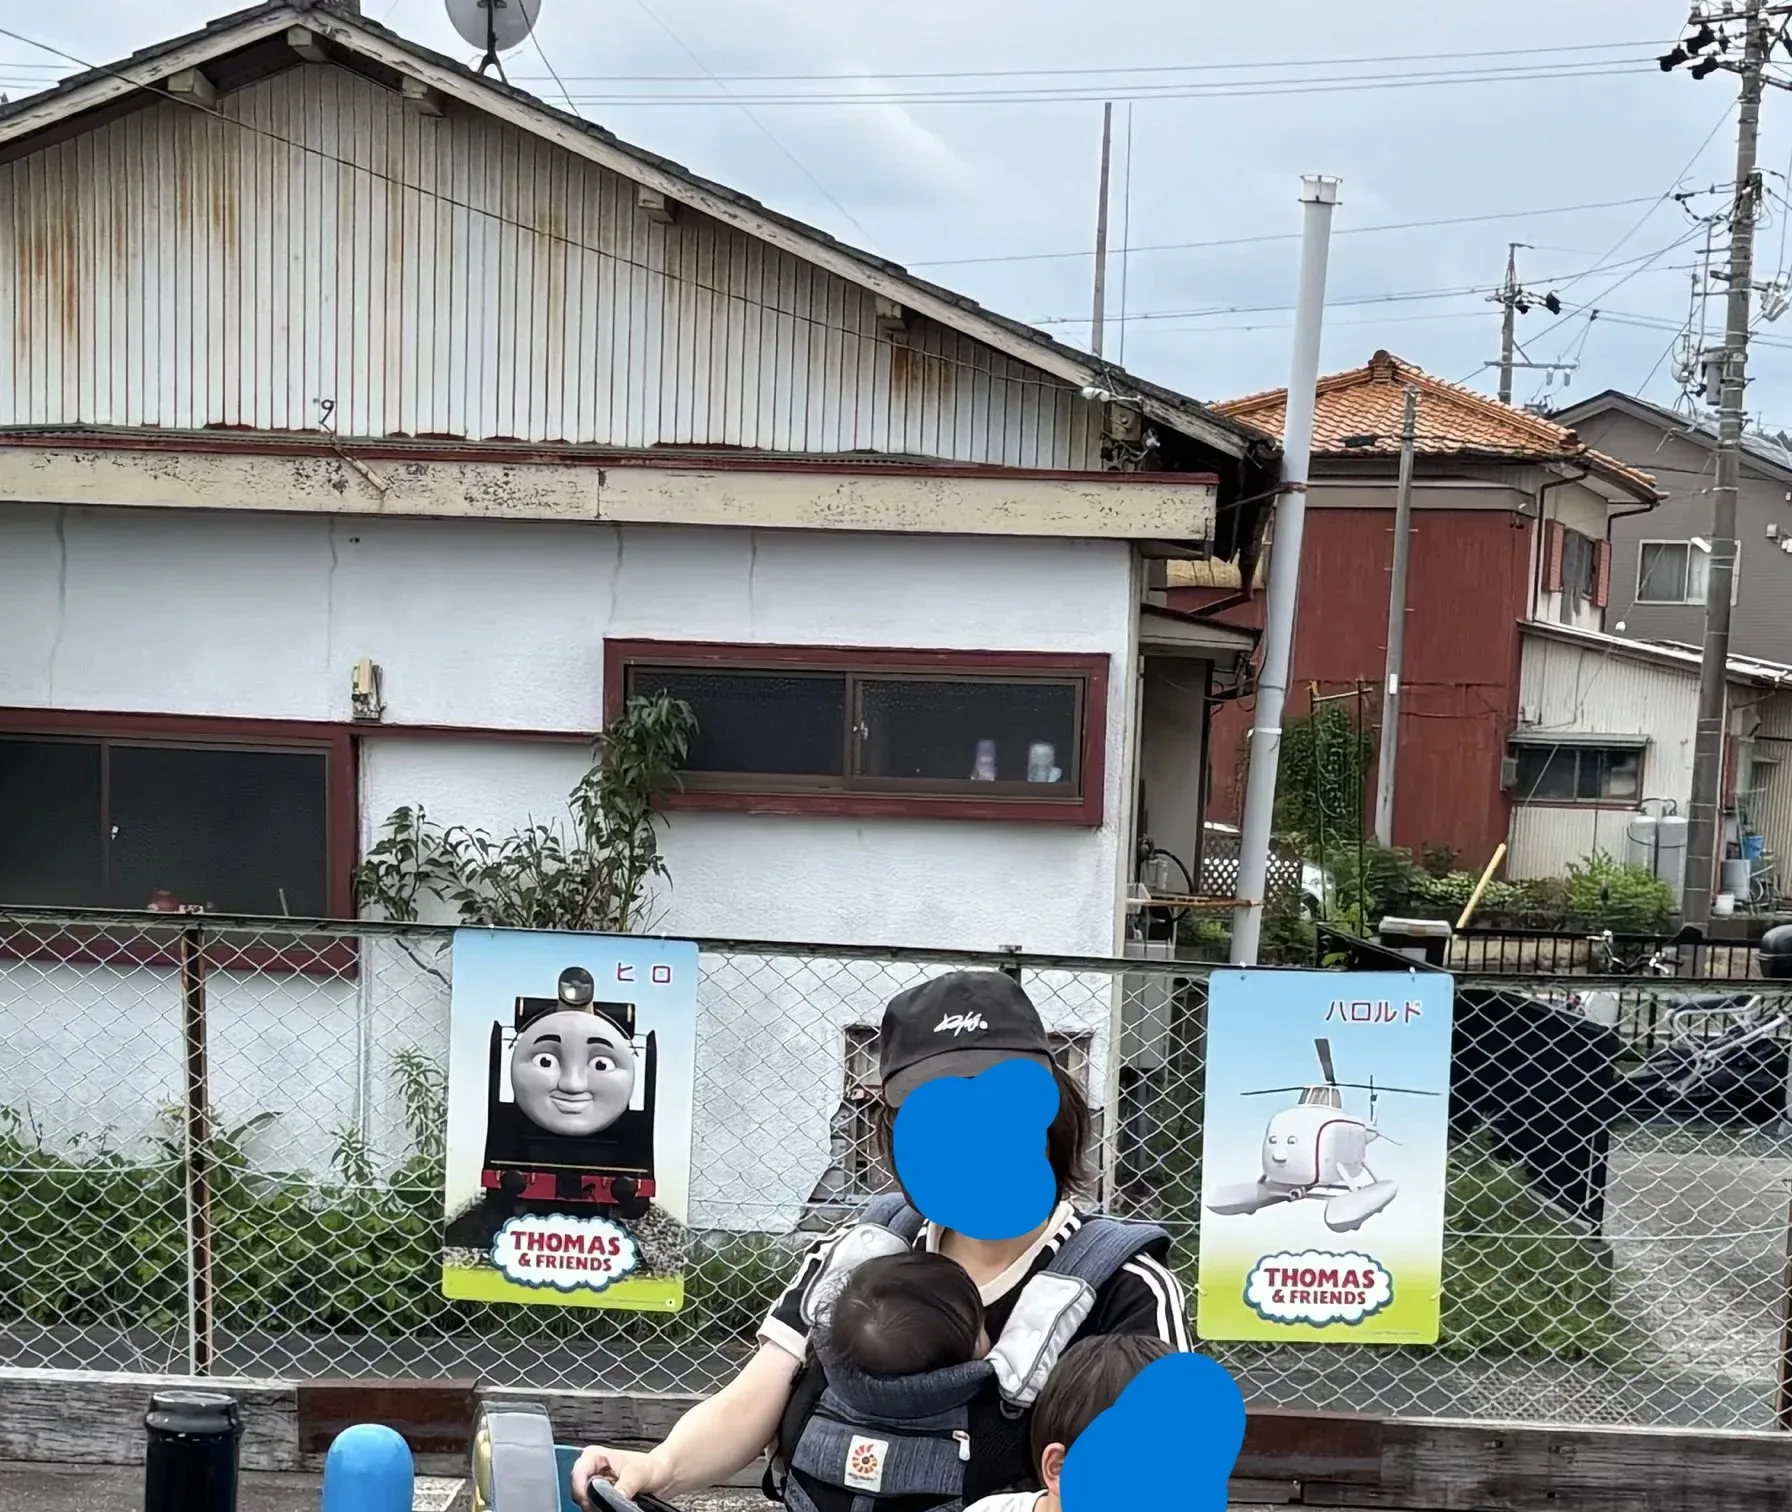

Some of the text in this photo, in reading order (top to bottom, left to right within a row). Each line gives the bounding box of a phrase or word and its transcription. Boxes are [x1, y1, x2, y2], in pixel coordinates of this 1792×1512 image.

[510, 1231, 621, 1256] THOMAS
[518, 1253, 612, 1271] & FRIENDS
[1264, 1268, 1375, 1289] THOMAS
[1272, 1289, 1366, 1305] & FRIENDS
